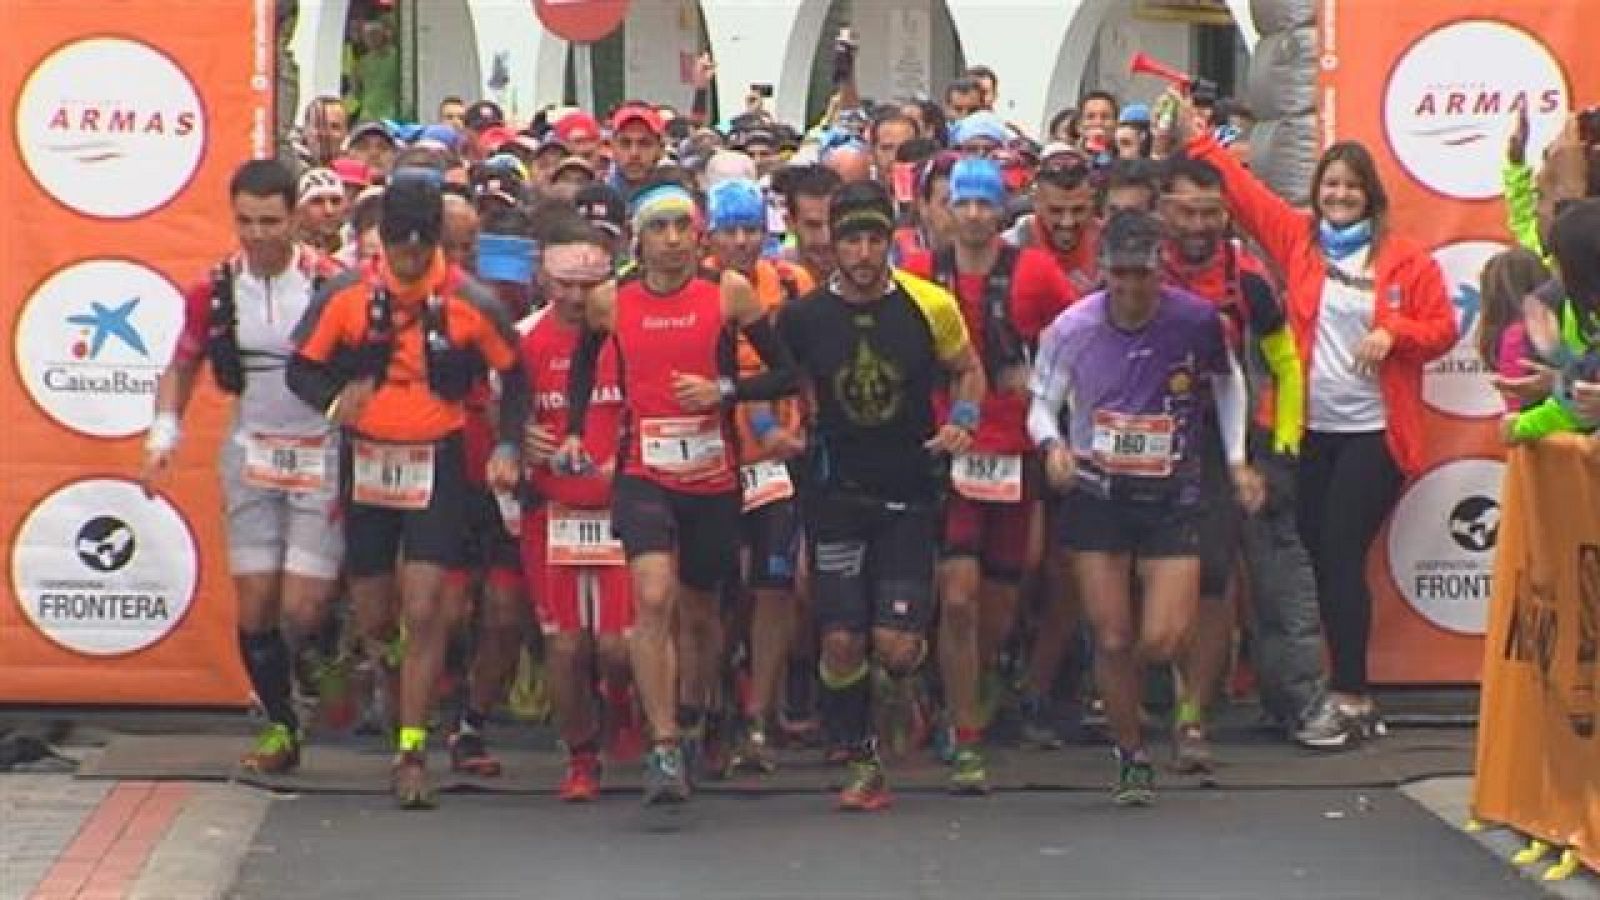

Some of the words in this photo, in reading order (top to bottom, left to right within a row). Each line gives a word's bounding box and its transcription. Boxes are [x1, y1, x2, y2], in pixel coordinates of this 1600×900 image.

[1415, 88, 1560, 116] ARMAS
[49, 108, 196, 136] ARMAS
[679, 439, 690, 461] 1
[578, 521, 602, 544] 111
[39, 595, 168, 620] FRONTERA
